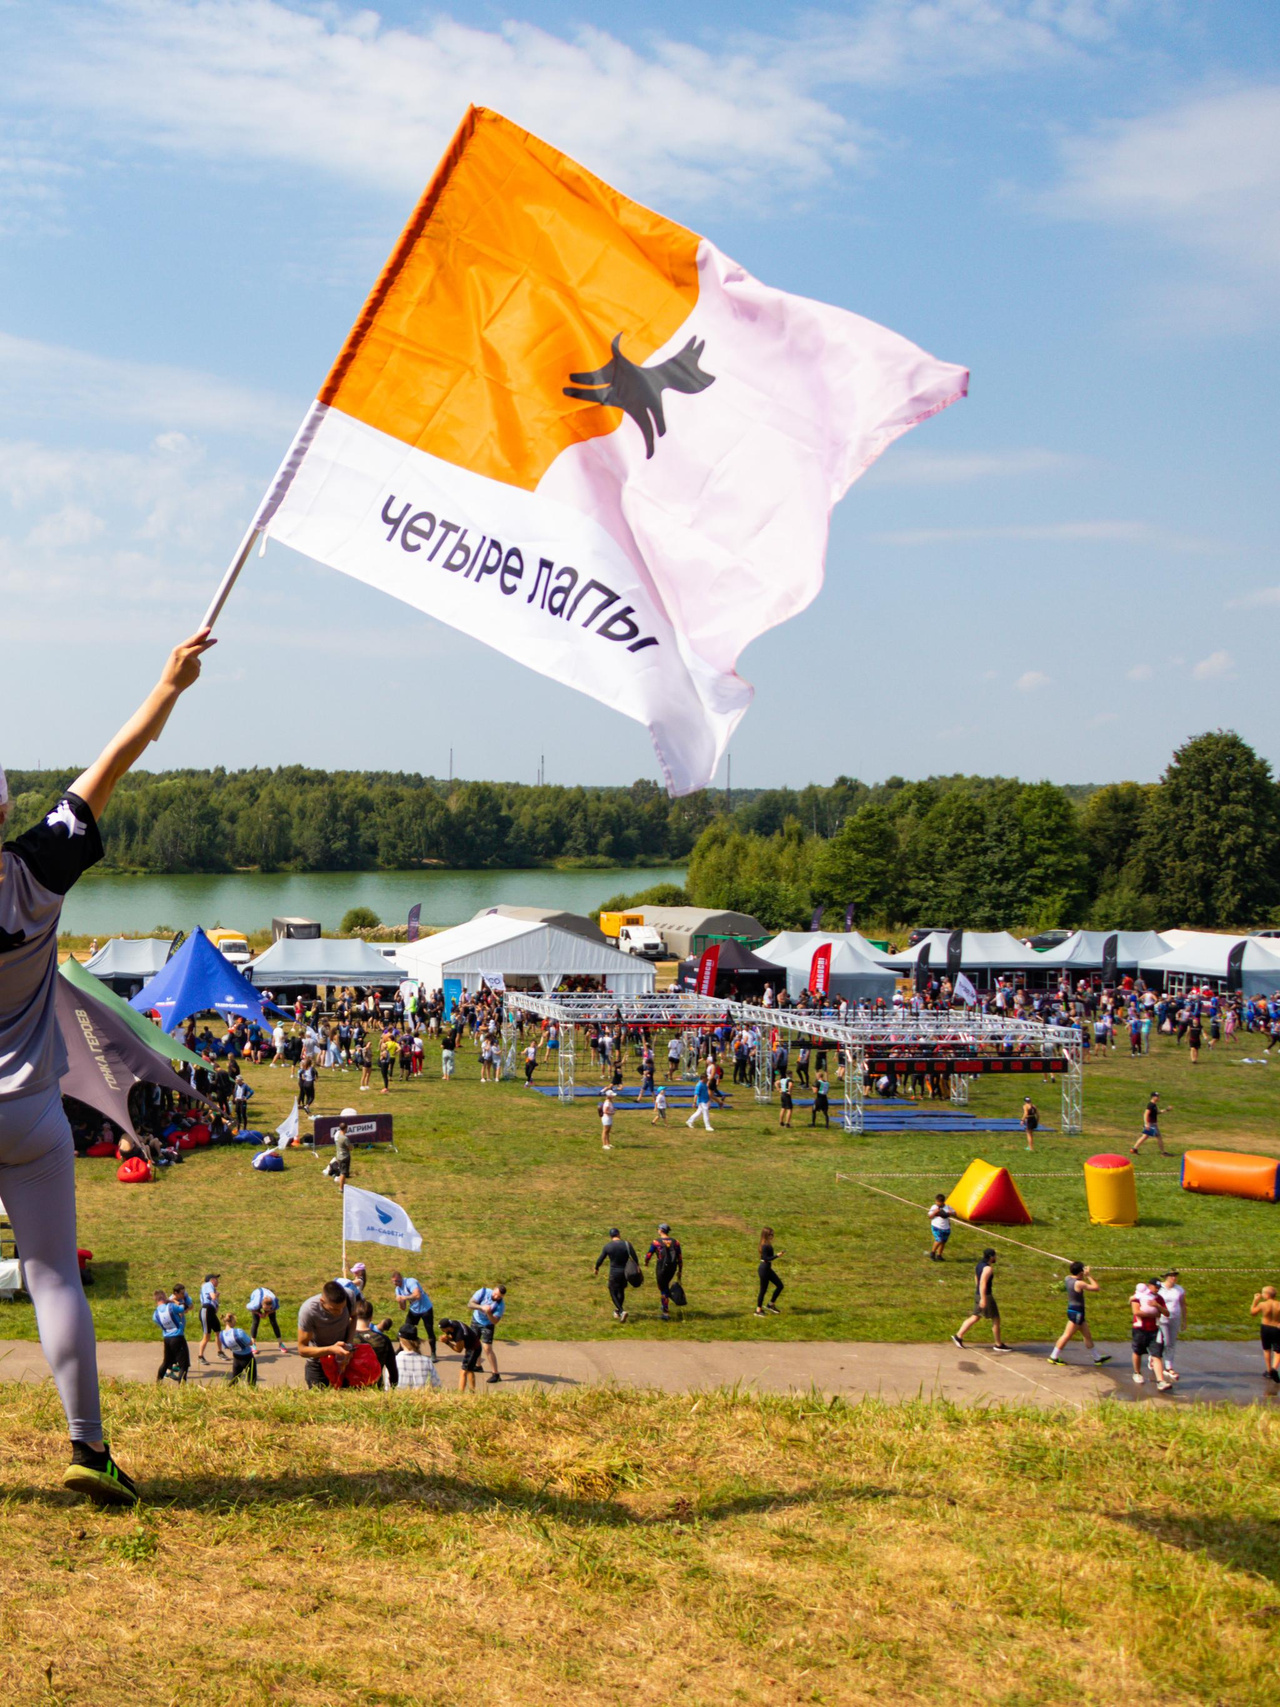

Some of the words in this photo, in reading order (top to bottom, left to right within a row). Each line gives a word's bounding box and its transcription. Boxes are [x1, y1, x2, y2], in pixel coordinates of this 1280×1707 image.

[701, 959, 713, 996] AMAGUCHI
[75, 1009, 102, 1053] ГЕРОЕВ
[95, 1055, 121, 1091] ГОНКА
[333, 1123, 373, 1136] ААГРИМ
